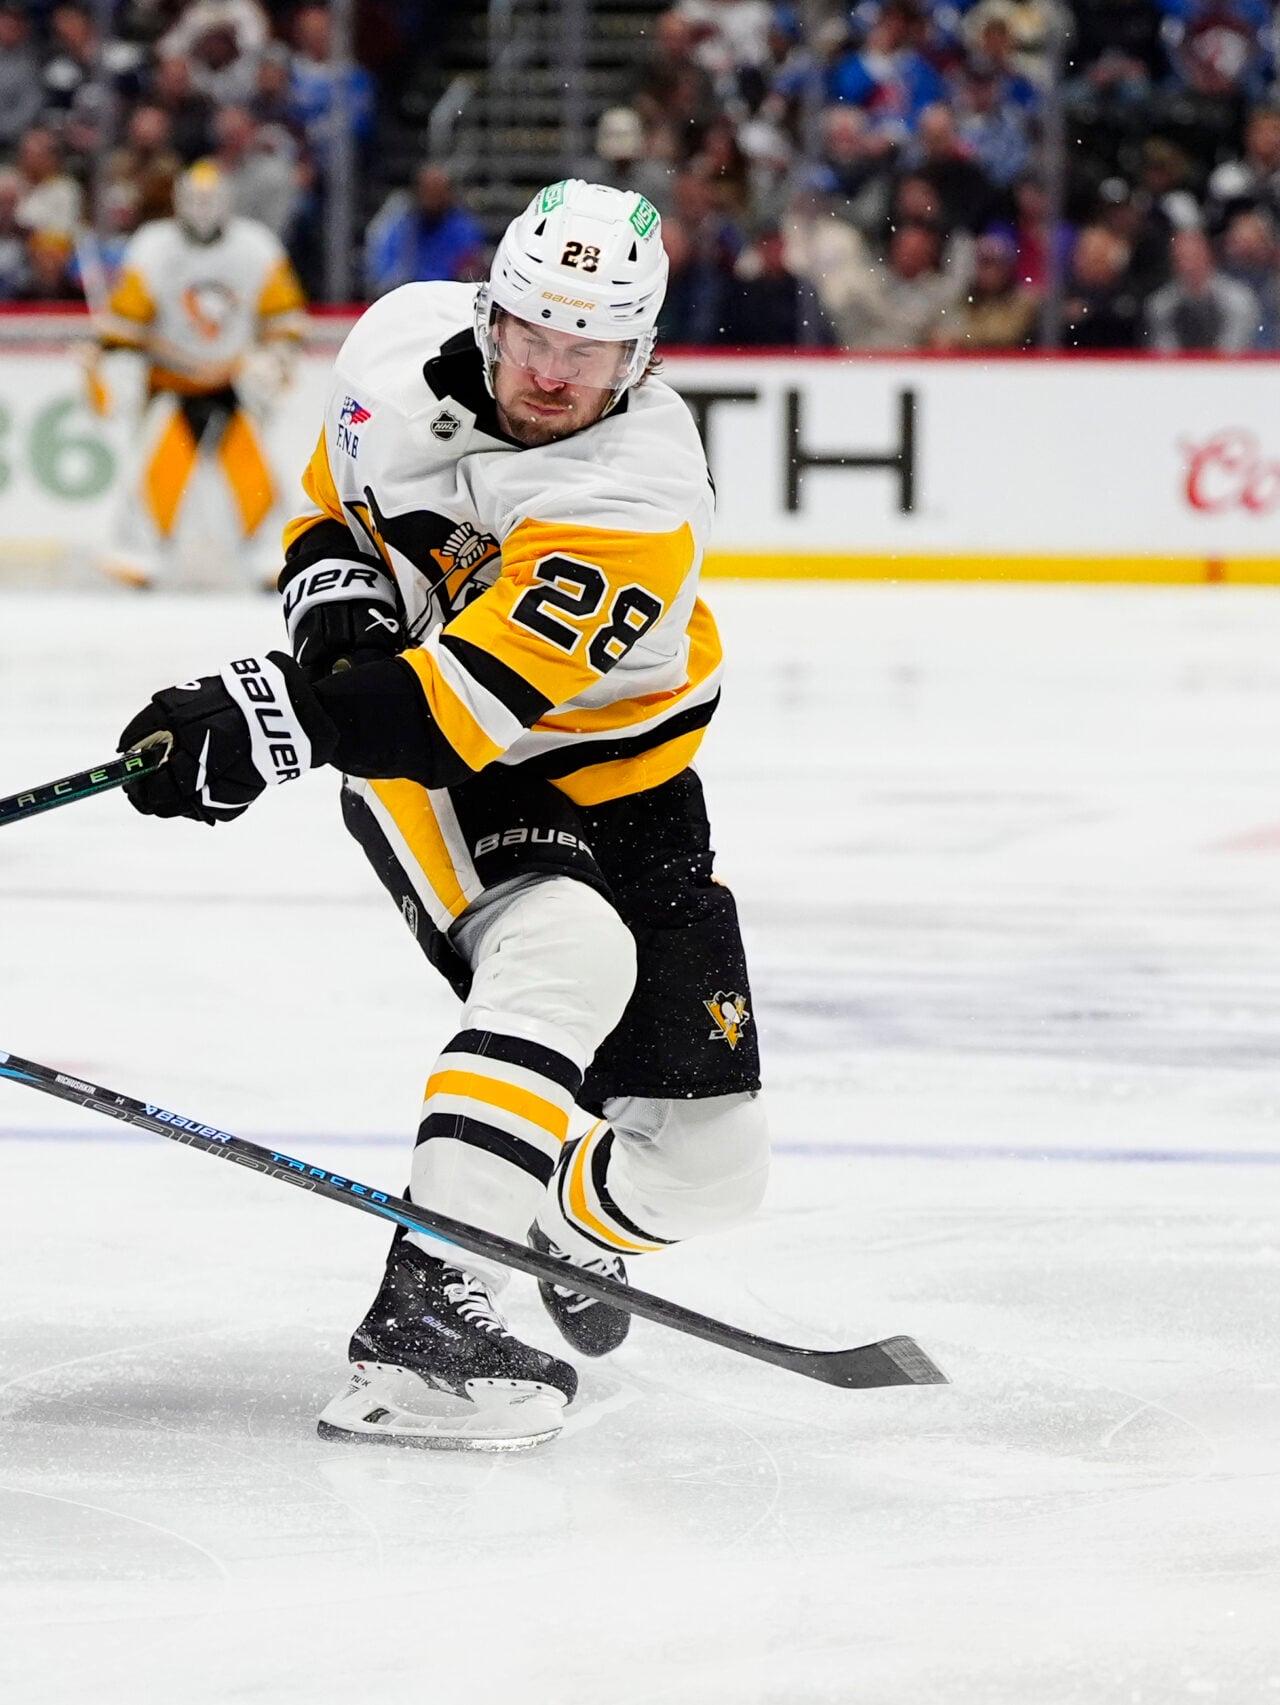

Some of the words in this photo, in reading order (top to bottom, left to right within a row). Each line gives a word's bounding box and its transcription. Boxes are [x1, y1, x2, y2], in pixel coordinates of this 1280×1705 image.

[560, 241, 601, 273] 28
[432, 422, 457, 431] NHL
[507, 552, 665, 679] 28
